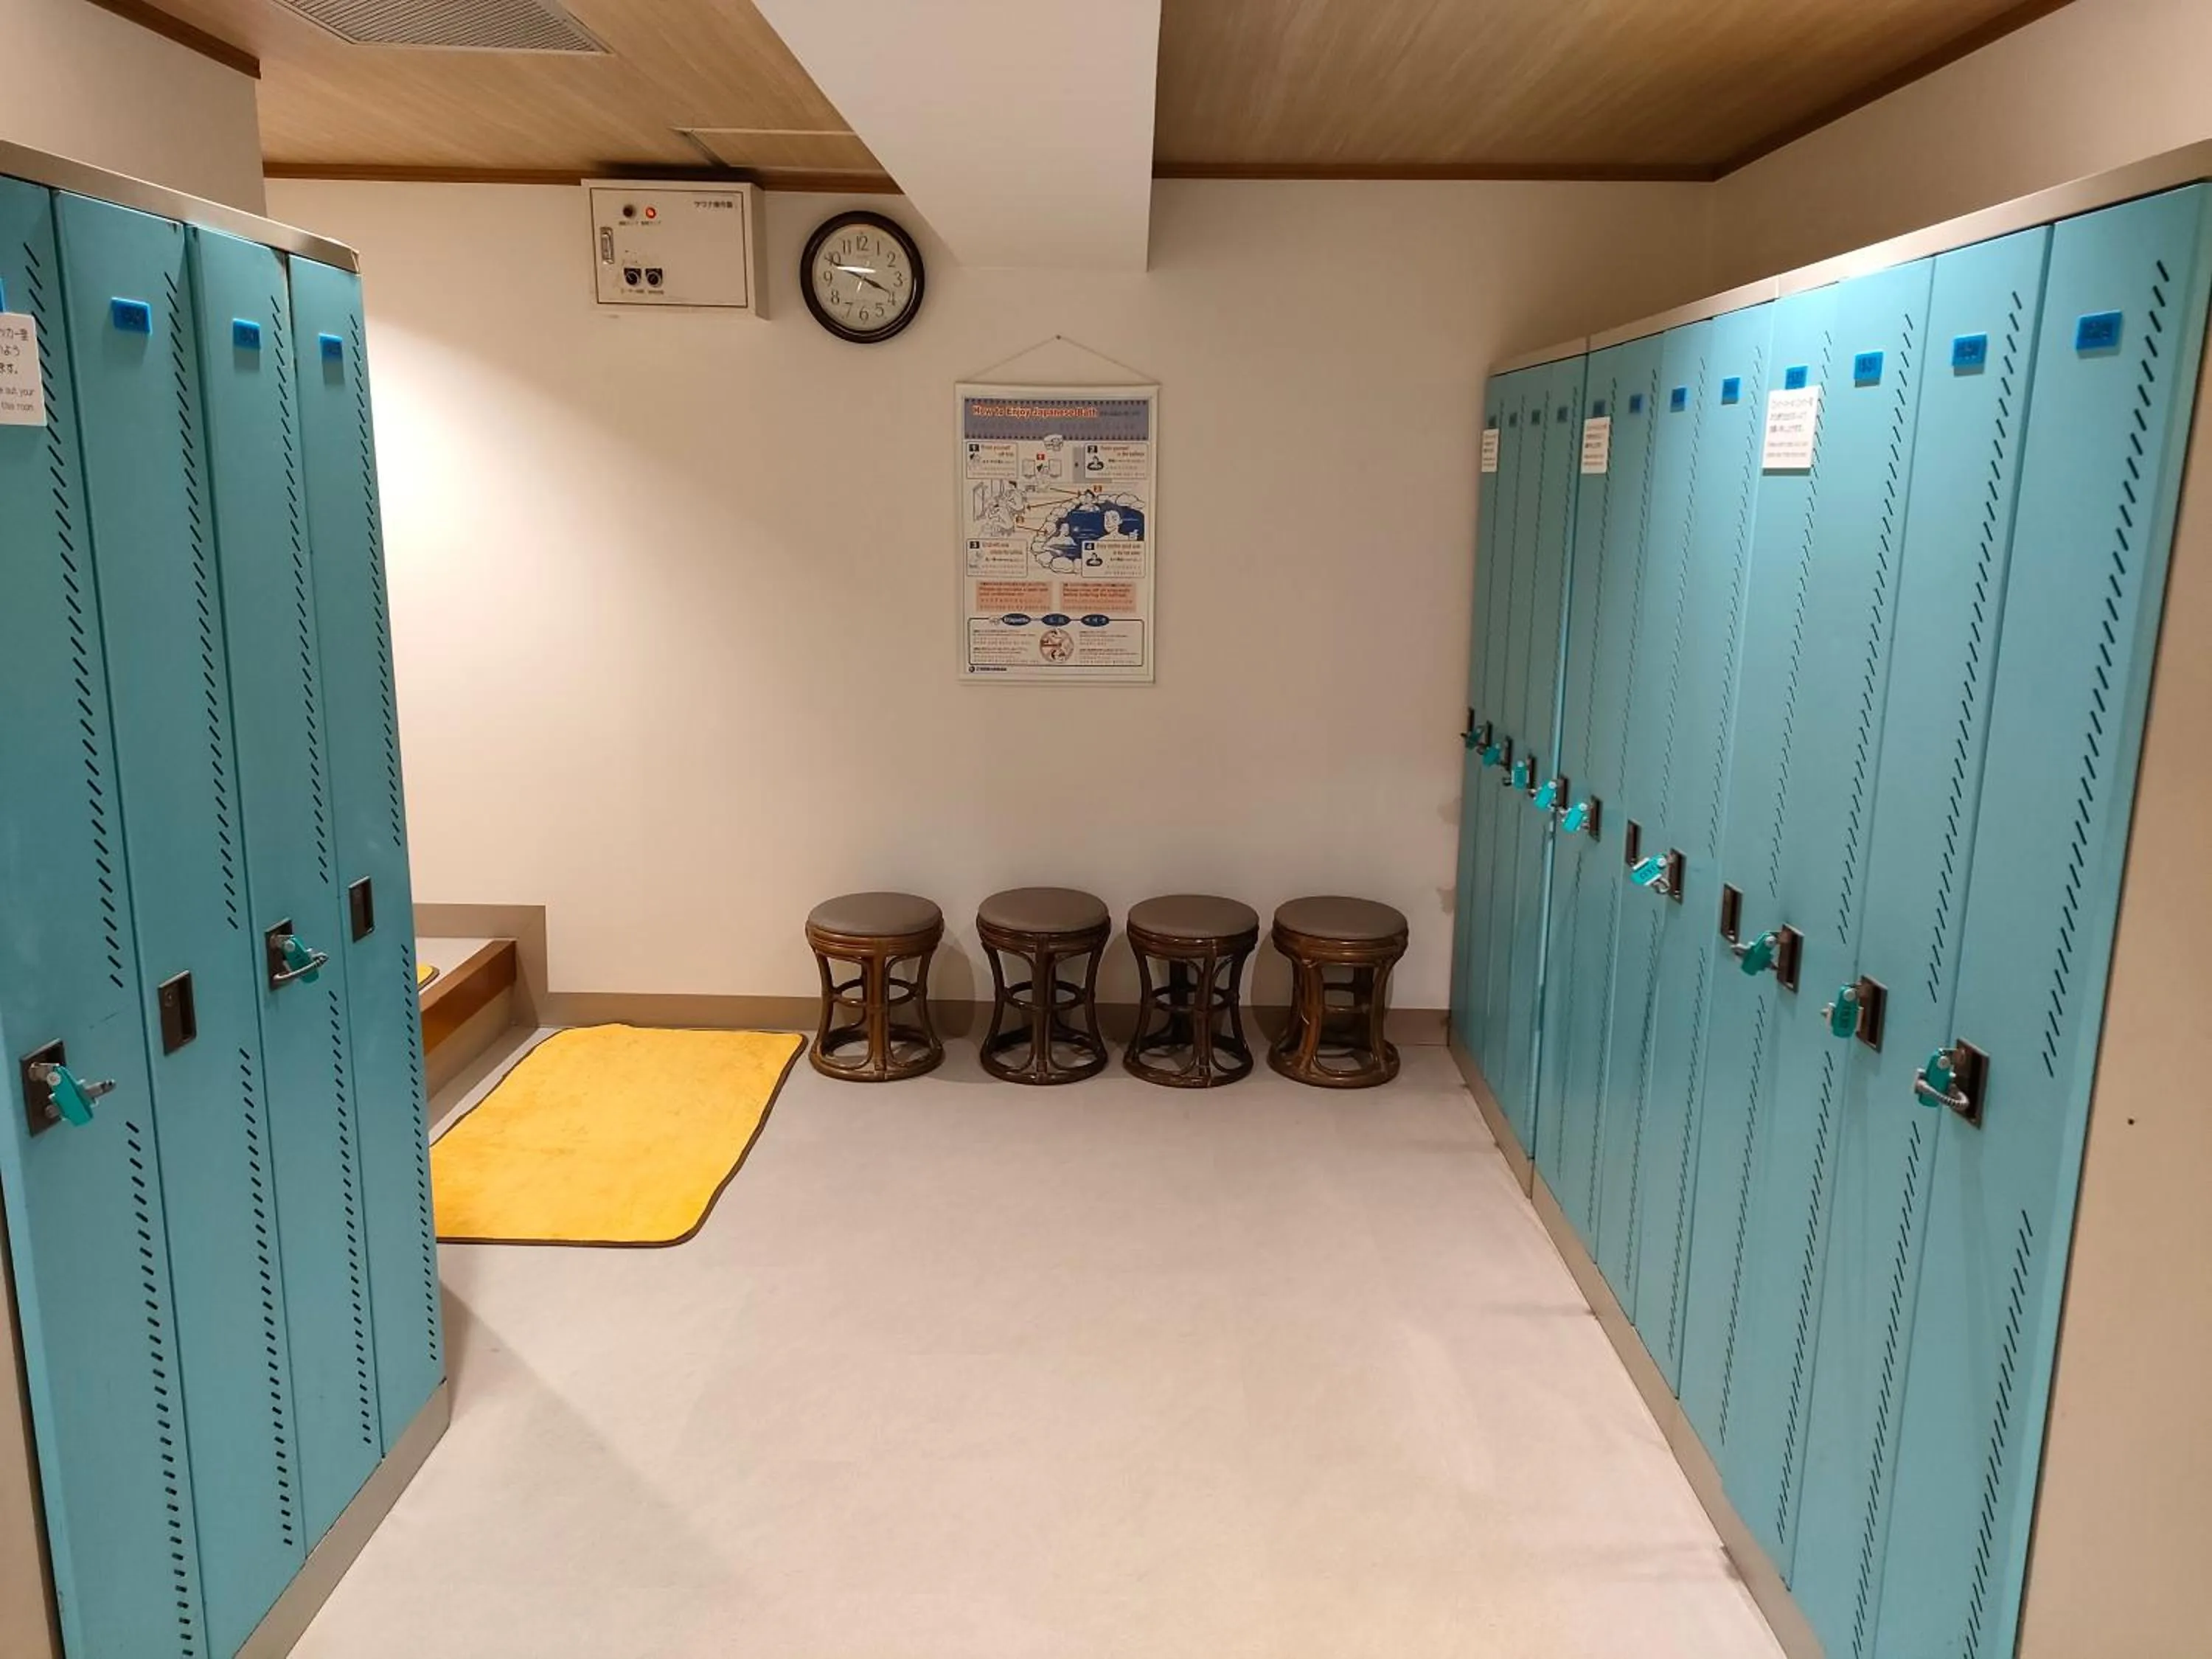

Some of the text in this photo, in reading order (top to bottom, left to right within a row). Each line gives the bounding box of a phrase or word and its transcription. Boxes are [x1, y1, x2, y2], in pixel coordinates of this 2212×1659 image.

[843, 239, 852, 255] 11
[856, 235, 870, 251] 12
[875, 240, 880, 256] 1
[887, 251, 896, 267] 2
[824, 271, 832, 287] 9
[893, 271, 903, 287] 3
[831, 289, 840, 305] 8
[887, 291, 896, 306] 4
[843, 301, 854, 319] 7
[859, 307, 869, 324] 6
[874, 302, 885, 318] 5
[1005, 406, 1032, 419] Enjoy
